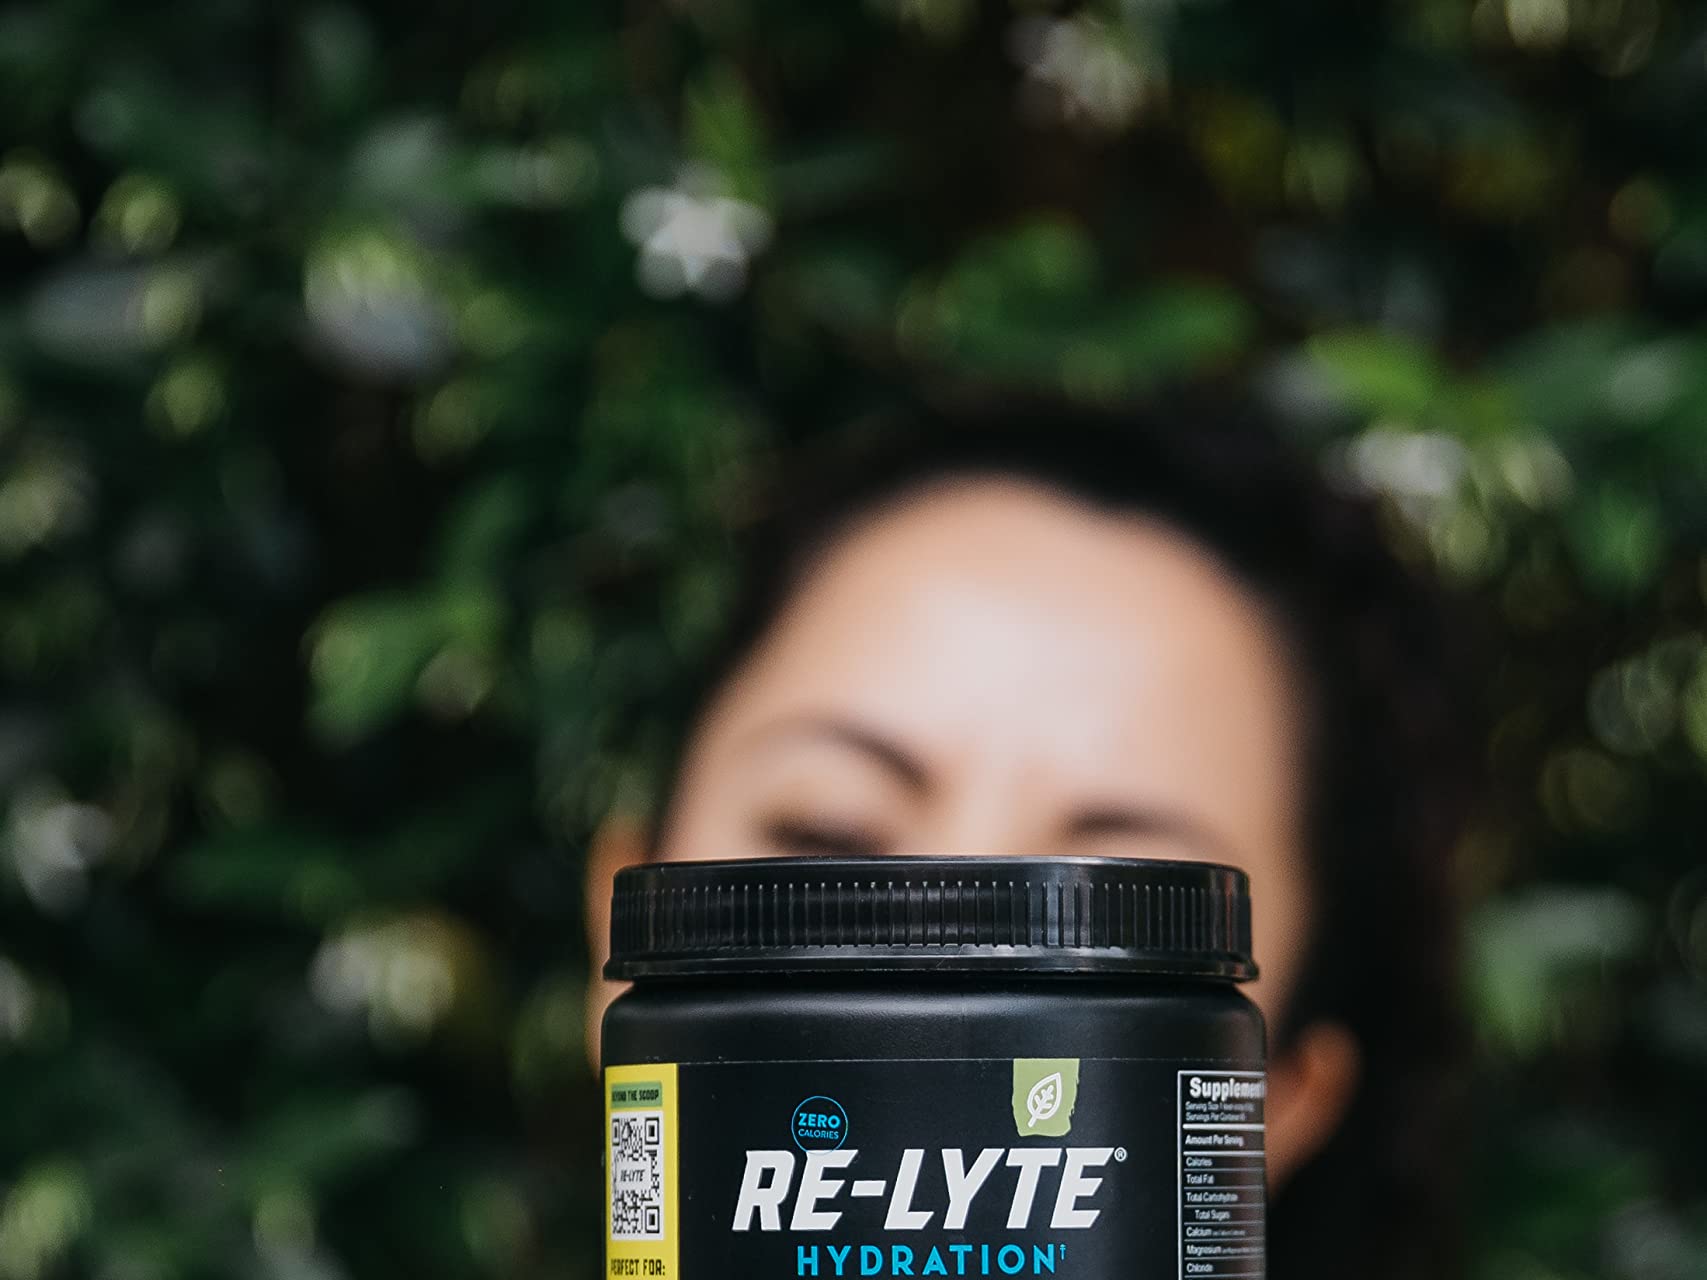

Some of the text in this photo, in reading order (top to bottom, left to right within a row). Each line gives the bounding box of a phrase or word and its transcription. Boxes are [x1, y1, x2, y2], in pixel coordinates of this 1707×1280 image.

[639, 1088, 660, 1101] SCOOP
[798, 1113, 841, 1128] ZERO
[798, 1128, 840, 1140] CALORIES
[1185, 1134, 1213, 1145] Amount
[1186, 1173, 1215, 1185] Total Fat
[1186, 1191, 1202, 1202] Total
[1194, 1208, 1211, 1220] Total
[1186, 1226, 1212, 1237] Calcium
[610, 1258, 667, 1276] PERFECT FOR:
